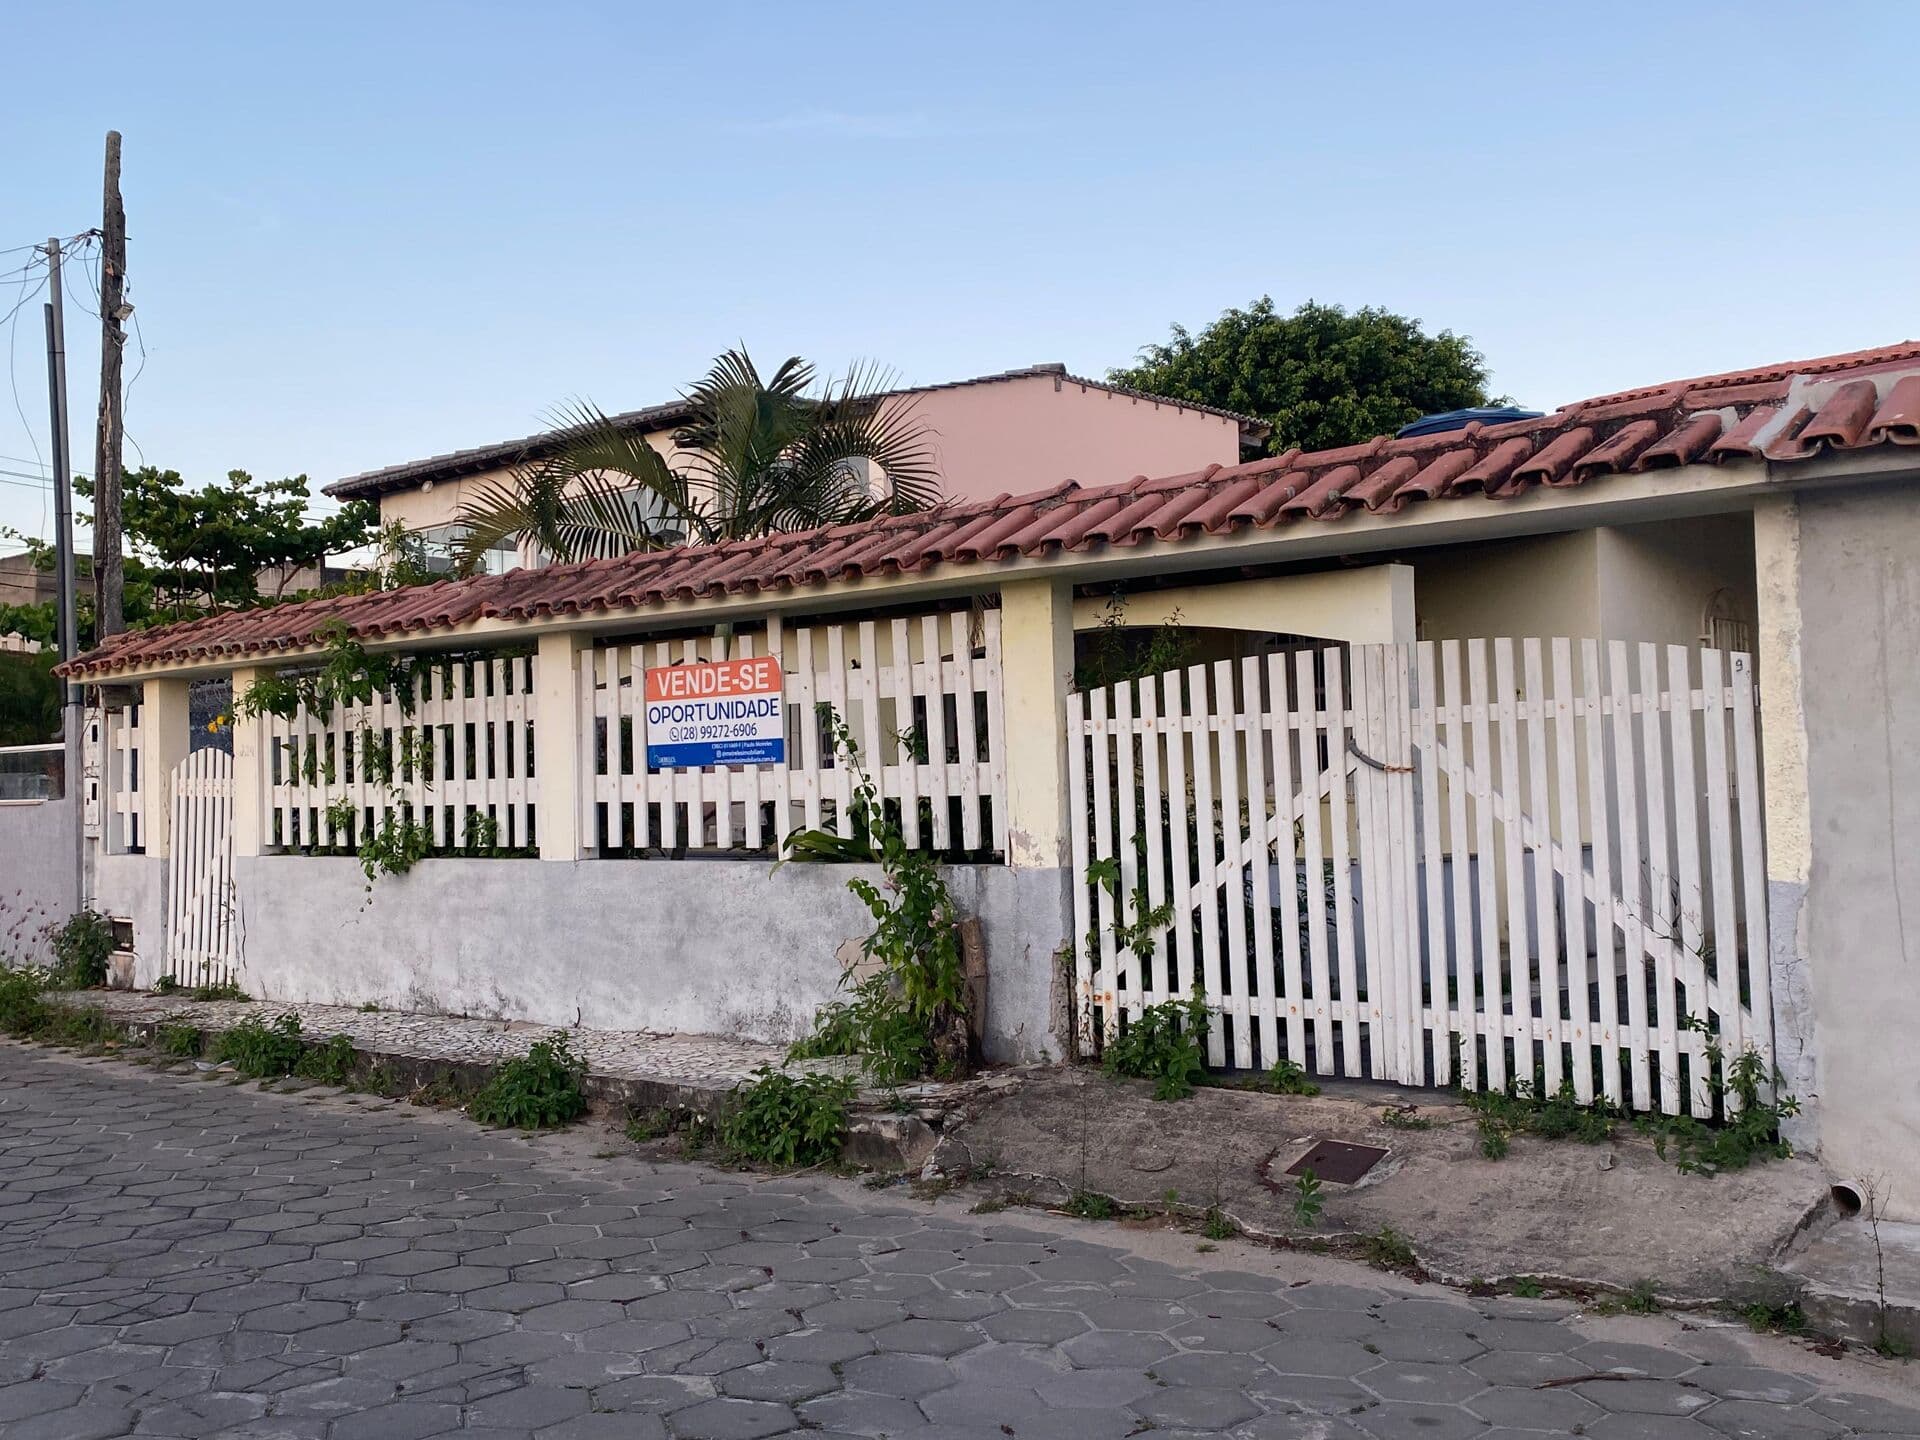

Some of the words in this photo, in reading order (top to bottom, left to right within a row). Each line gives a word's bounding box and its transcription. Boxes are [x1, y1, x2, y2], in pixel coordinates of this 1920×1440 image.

[657, 663, 769, 697] VENDE-SE
[649, 698, 779, 724] OPORTUNIDADE
[680, 726, 698, 740] (28)
[700, 723, 758, 739] 99272-6906
